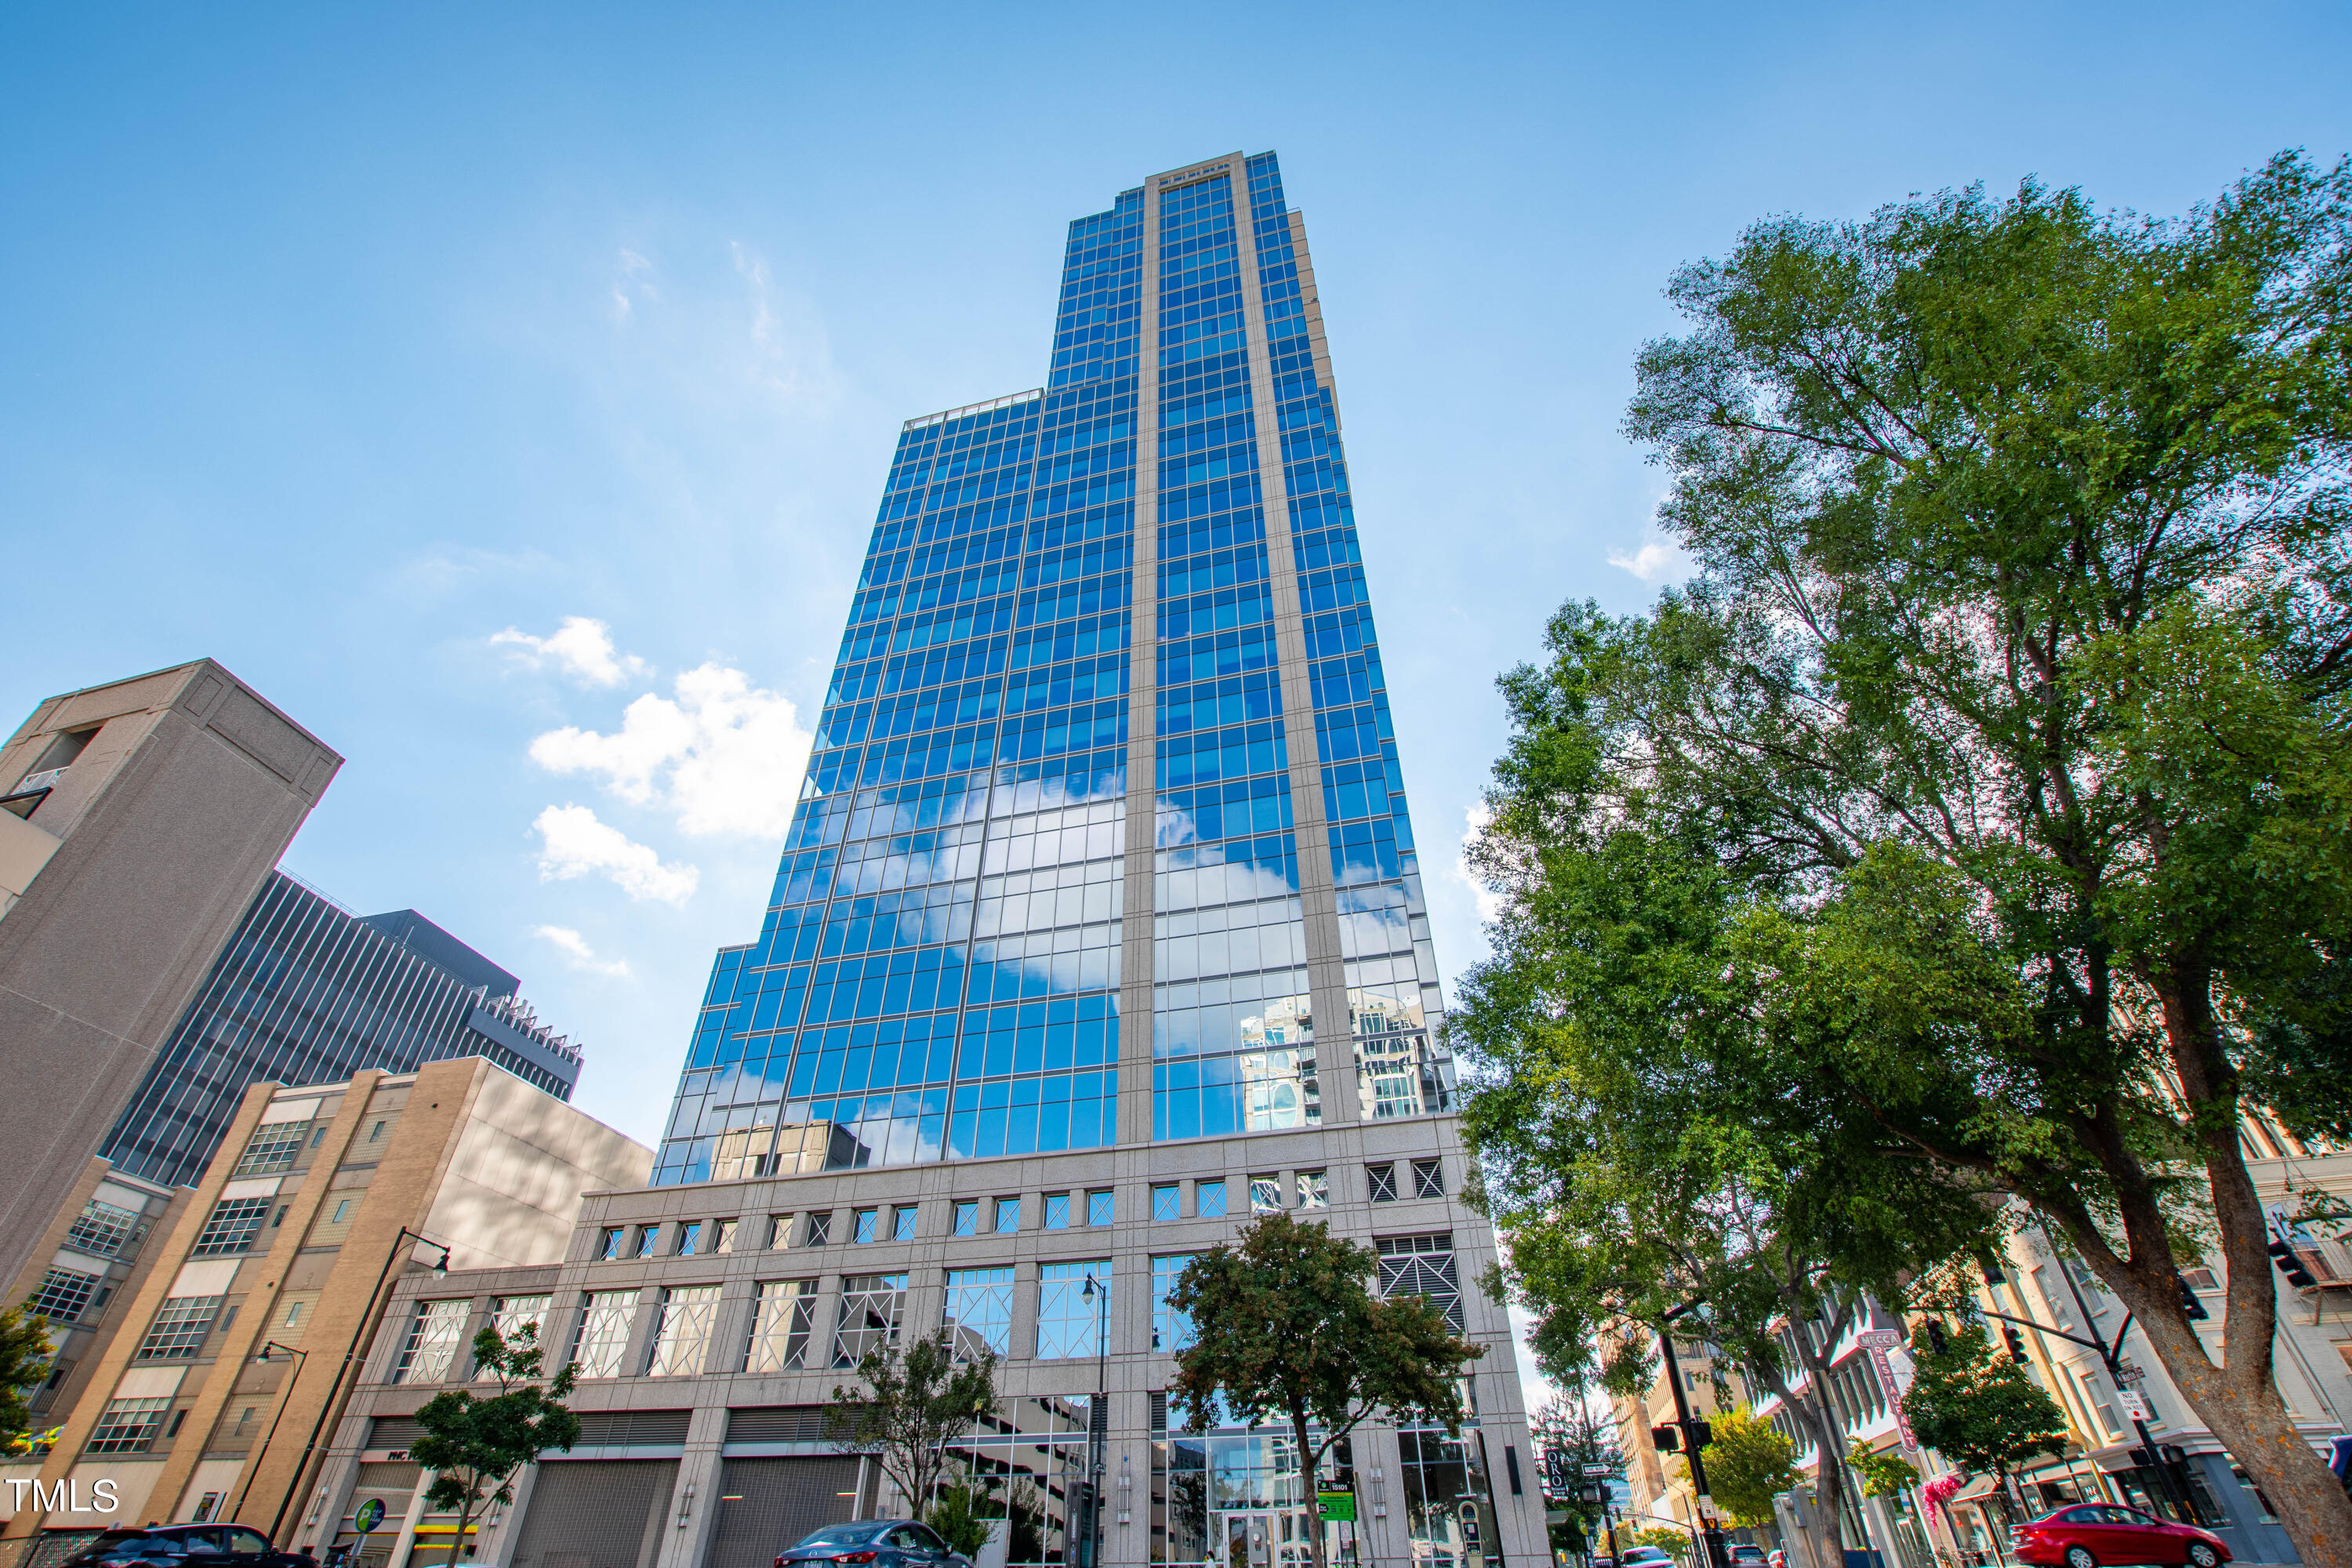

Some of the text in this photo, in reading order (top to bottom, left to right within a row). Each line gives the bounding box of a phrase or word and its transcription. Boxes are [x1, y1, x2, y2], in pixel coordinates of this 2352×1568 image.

[1860, 1334, 1897, 1345] MECCA
[1874, 1345, 1915, 1447] RESTAURANT
[387, 1451, 408, 1461] PNC
[1548, 1452, 1562, 1486] ORO
[360, 1508, 372, 1522] P
